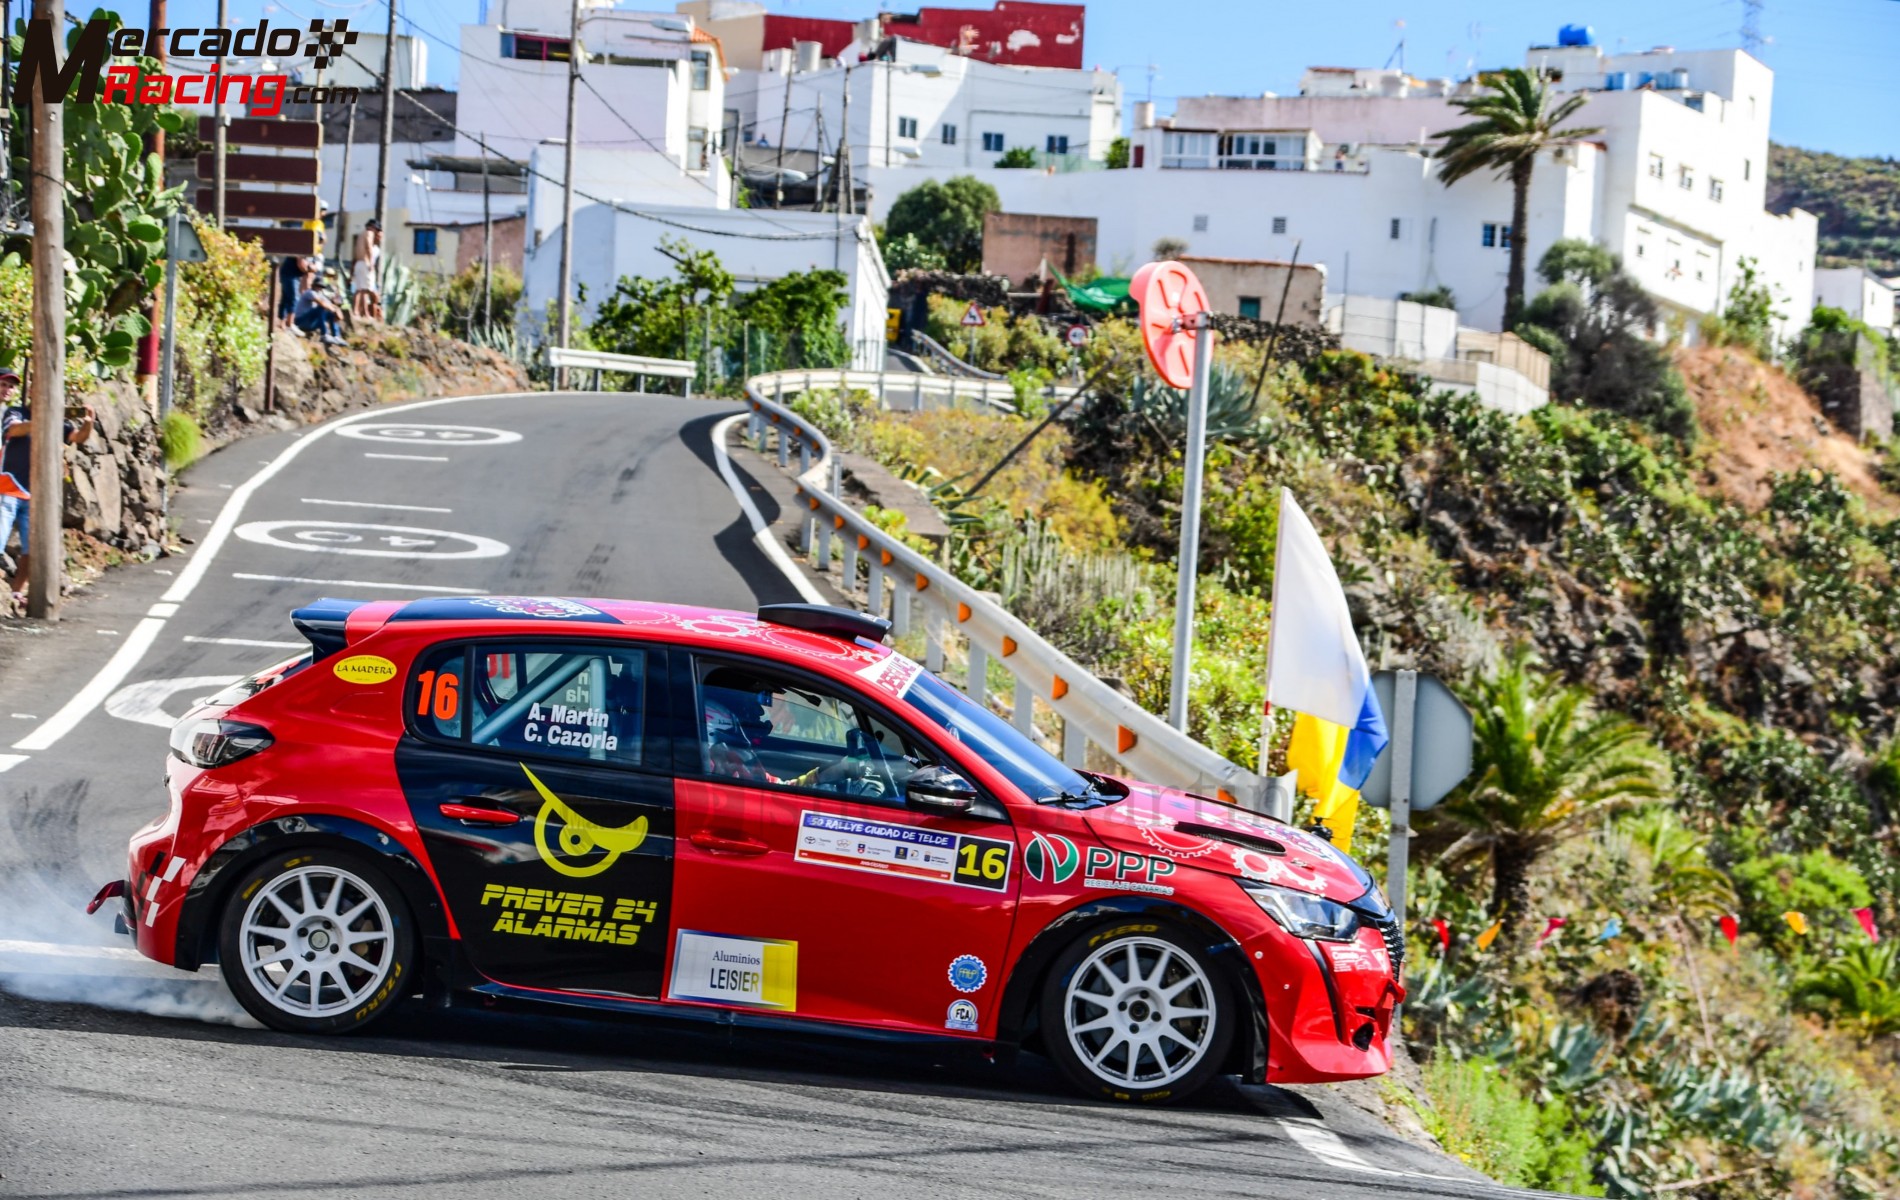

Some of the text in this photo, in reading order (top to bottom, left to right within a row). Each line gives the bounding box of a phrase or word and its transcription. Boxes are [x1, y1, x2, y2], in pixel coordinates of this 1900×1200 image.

[351, 665, 393, 675] MADERA
[417, 670, 459, 720] 16
[528, 702, 609, 728] A. Martín
[524, 722, 618, 751] C. Cazorla
[825, 819, 865, 832] RALLYE
[865, 825, 901, 838] CIUDAD
[902, 830, 916, 840] DE
[918, 833, 949, 846] TELDE
[957, 844, 1007, 880] 16
[1085, 846, 1176, 883] PPP
[1084, 878, 1175, 895] RECICLAJE CANARIAS
[480, 883, 657, 923] PREVER 24
[492, 911, 641, 946] ALARMAS
[712, 950, 760, 965] Aluminios
[710, 968, 759, 992] LEISIER
[955, 1008, 970, 1020] FCA
